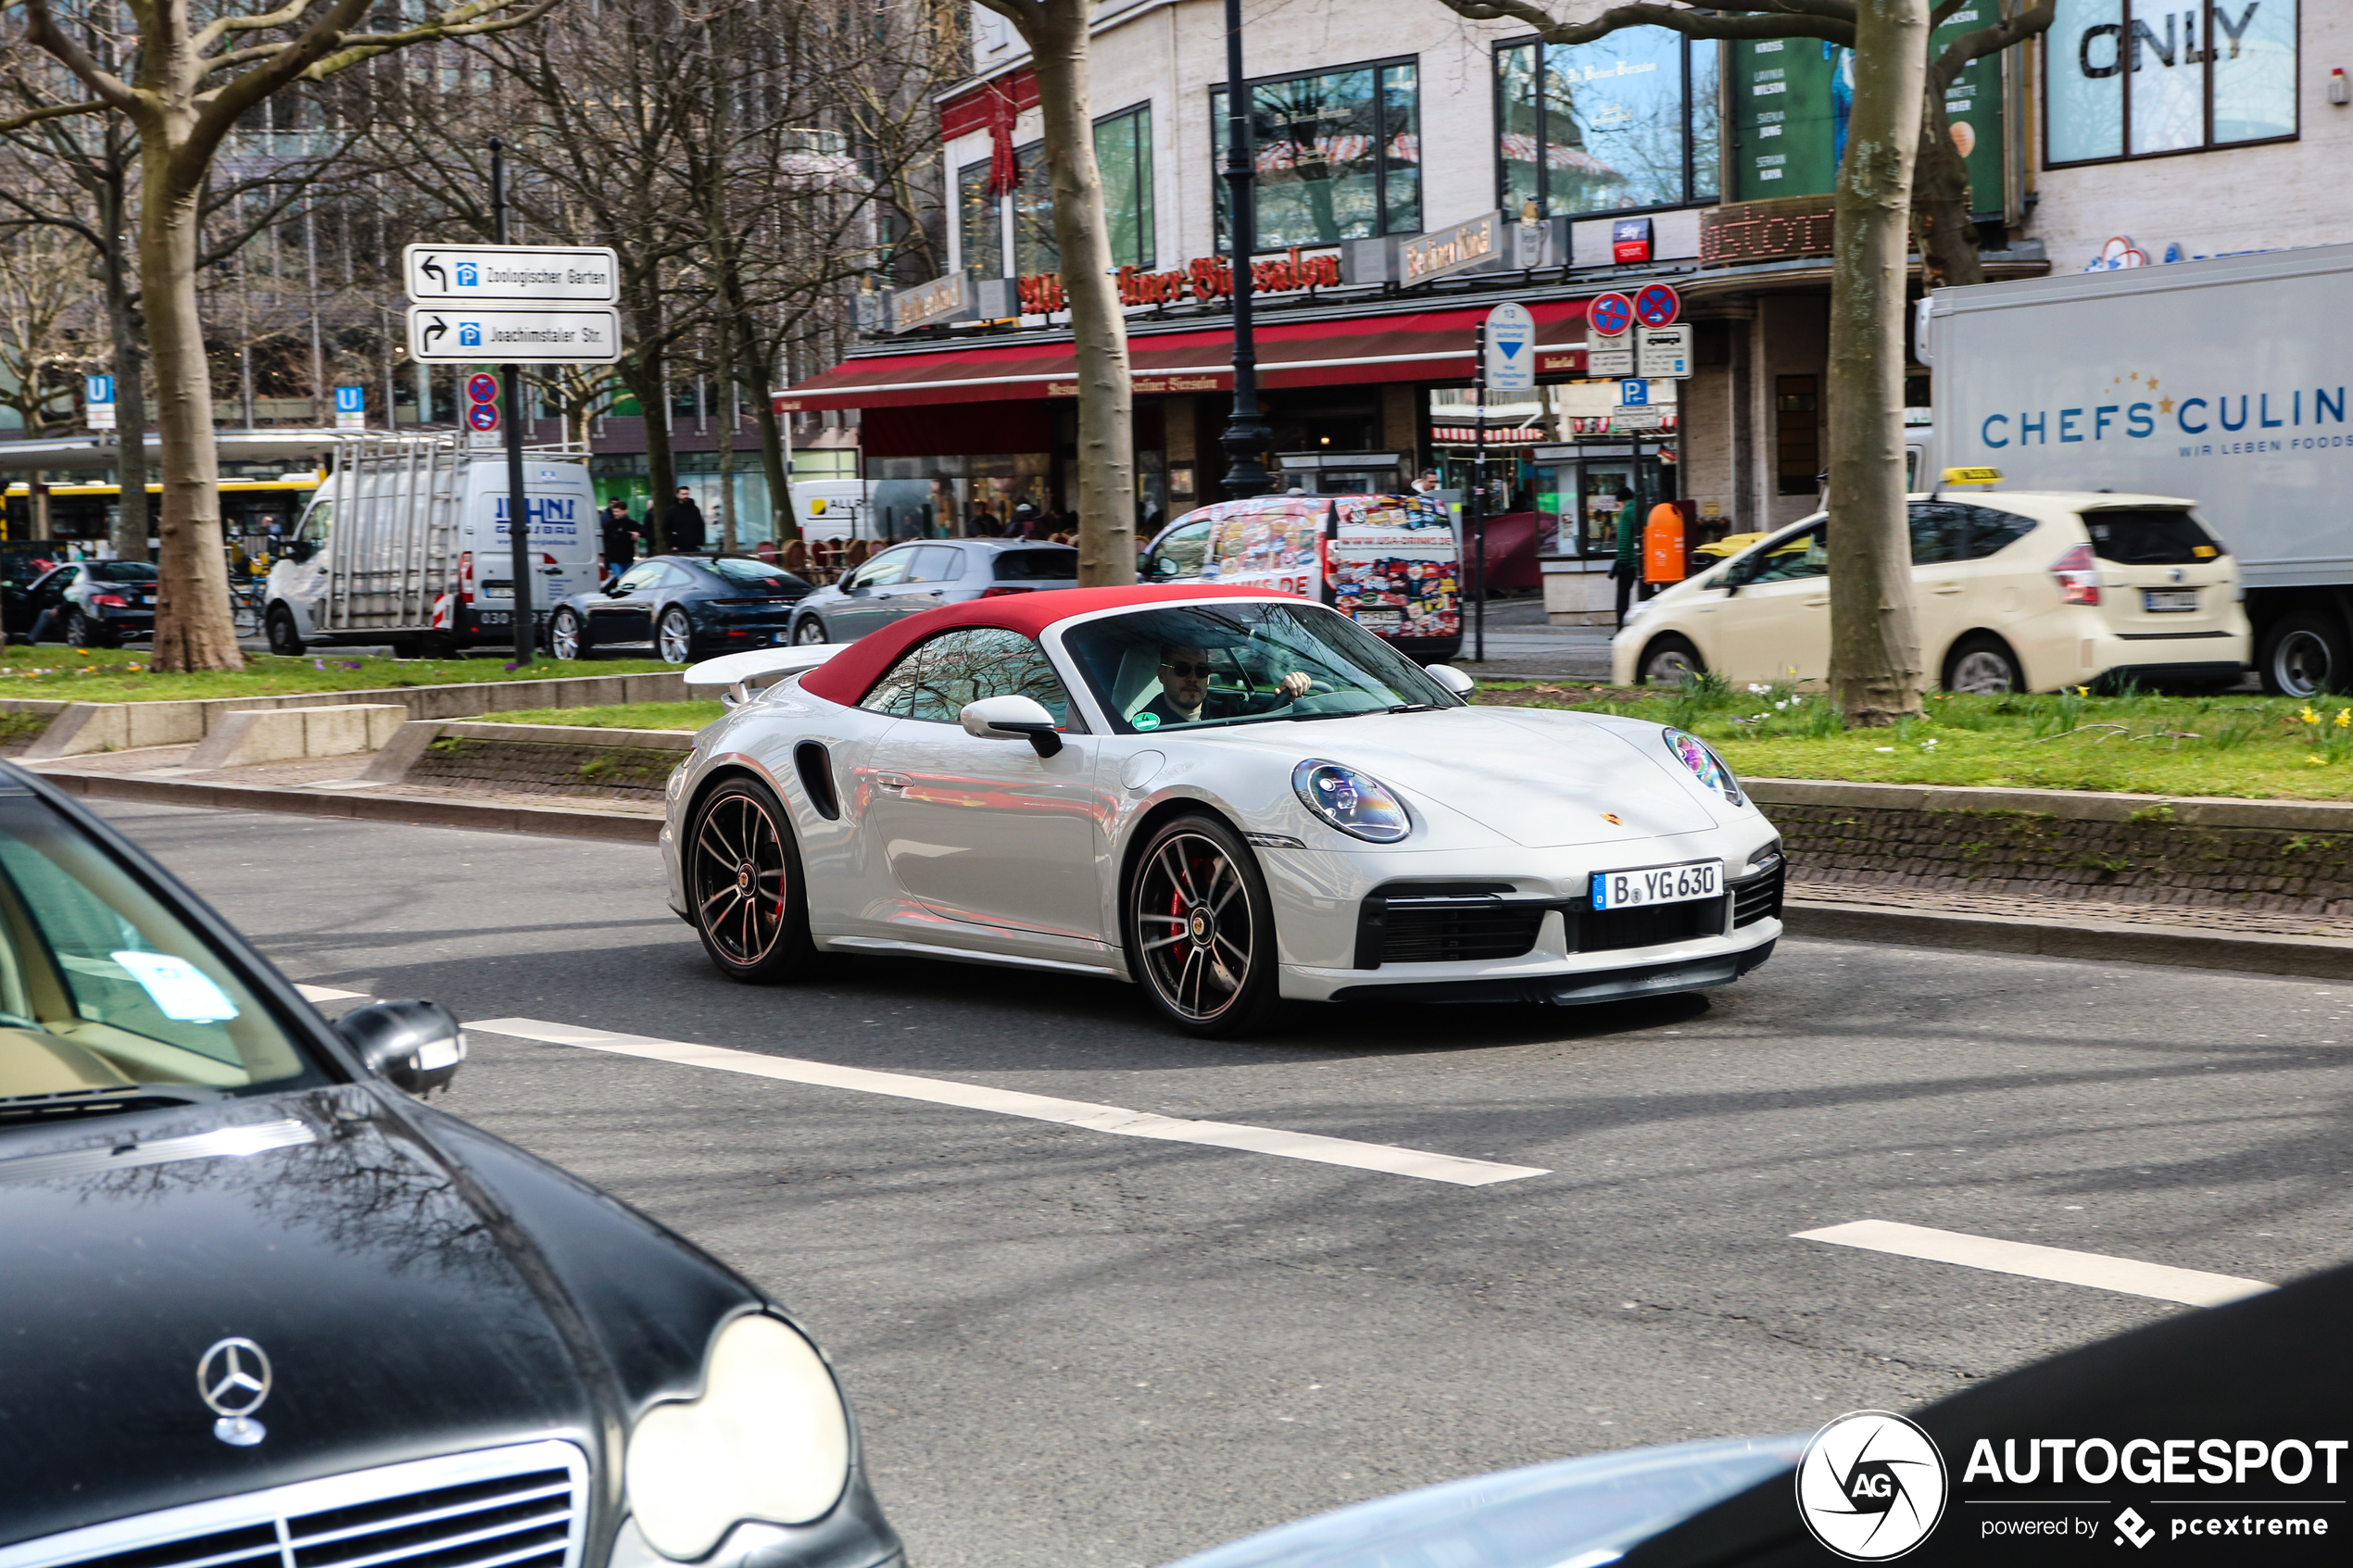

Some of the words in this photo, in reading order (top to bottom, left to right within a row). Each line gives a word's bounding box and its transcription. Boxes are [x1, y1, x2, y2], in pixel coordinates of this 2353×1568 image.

[2080, 2, 2260, 79] ONLY
[1620, 224, 1641, 240] sky
[1619, 246, 1642, 257] sport
[486, 266, 562, 287] Zoologischer
[568, 269, 607, 285] Garten
[1504, 308, 1516, 319] 13
[490, 327, 575, 343] Joachimstaler
[582, 327, 604, 343] Str.
[88, 378, 107, 401] U
[338, 389, 358, 409] U
[1625, 383, 1641, 403] P
[1982, 402, 2155, 448] CHEFS
[2179, 386, 2353, 434] CULIN
[2179, 444, 2212, 458] WIR
[2221, 440, 2281, 455] LEBEN
[481, 612, 509, 624] 030
[1596, 895, 1604, 904] D
[1615, 875, 1629, 904] B
[1645, 870, 1673, 900] YG
[1678, 866, 1715, 897] 630
